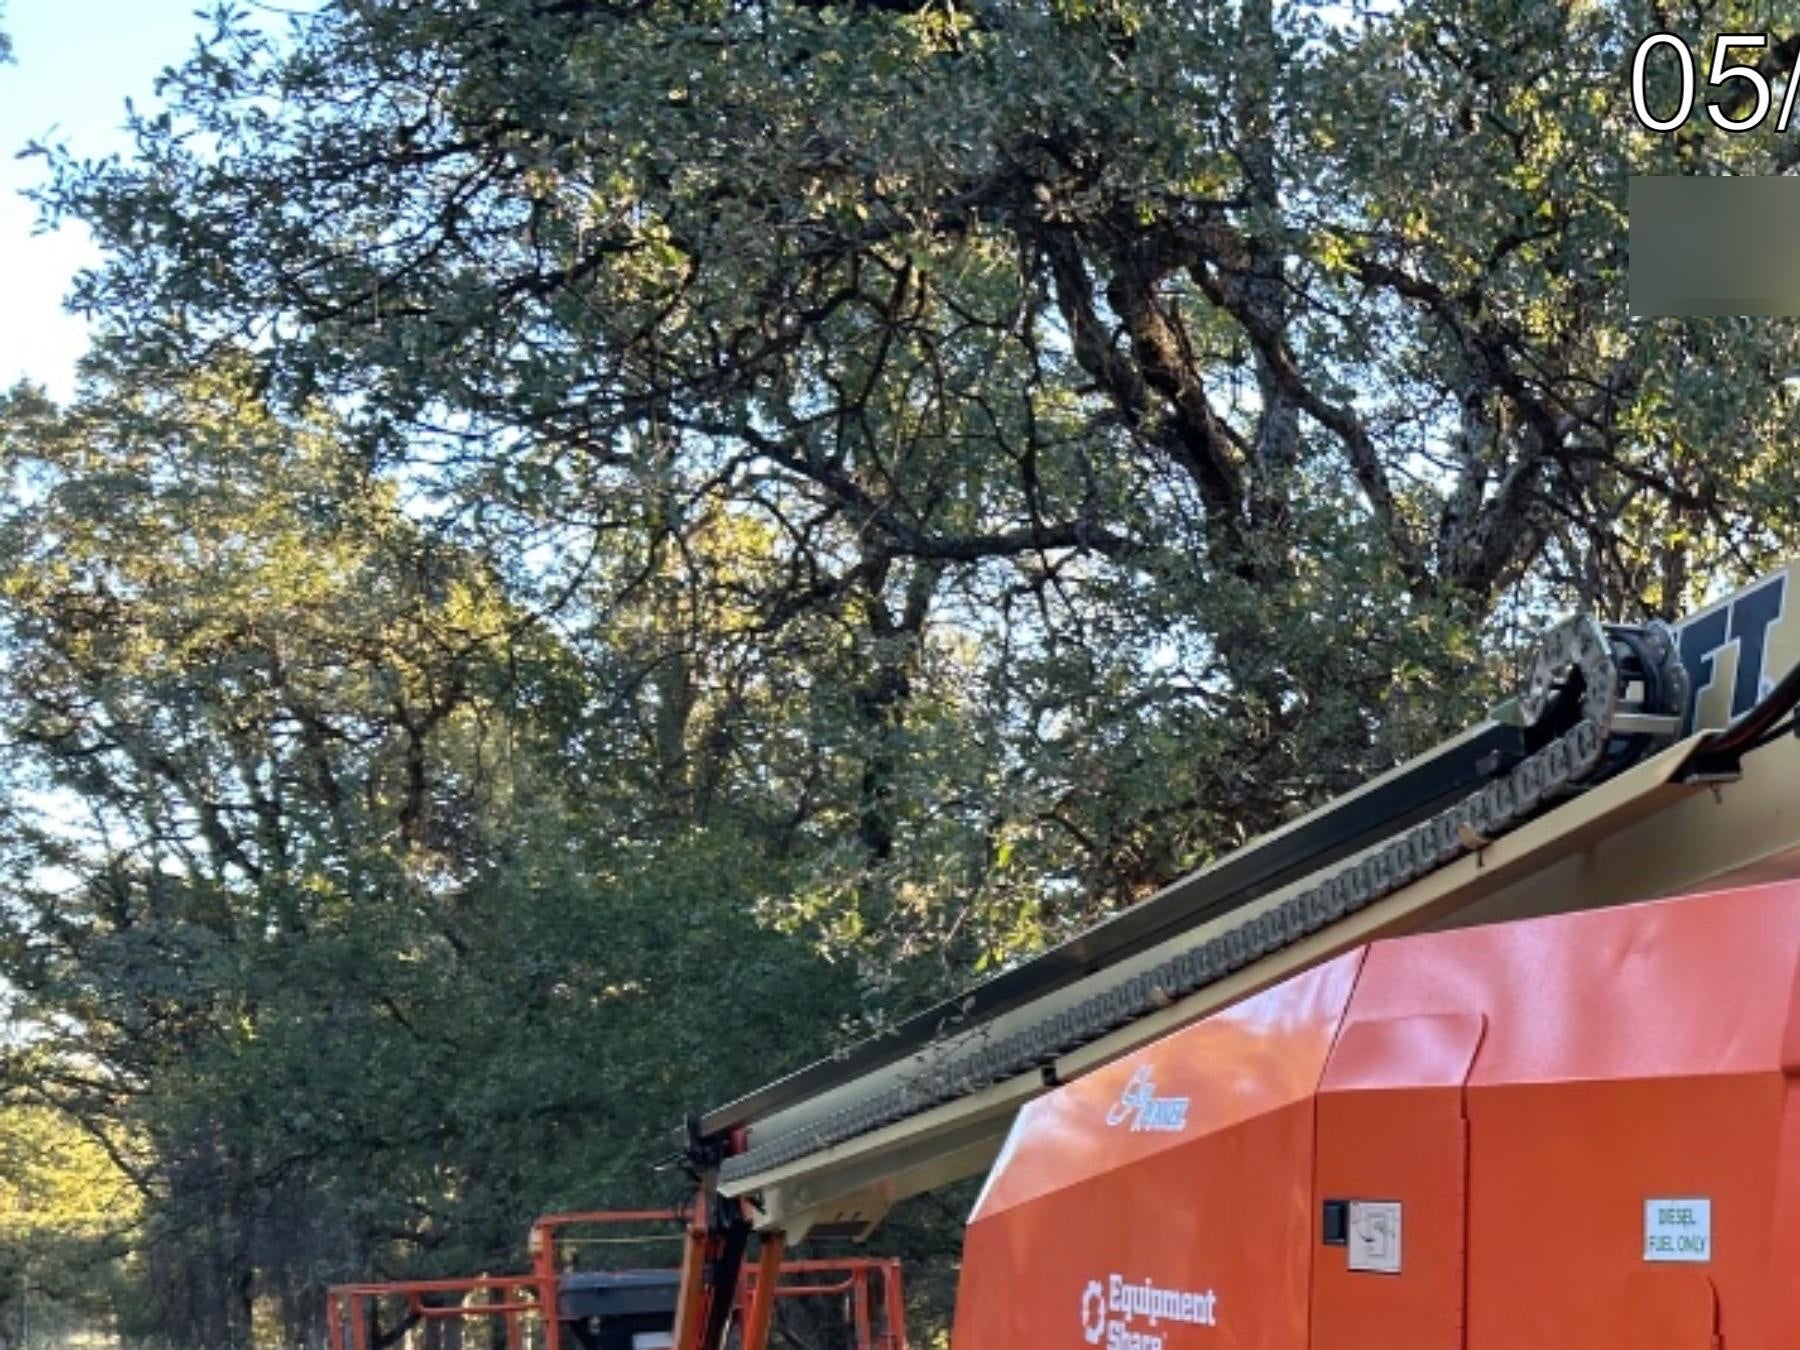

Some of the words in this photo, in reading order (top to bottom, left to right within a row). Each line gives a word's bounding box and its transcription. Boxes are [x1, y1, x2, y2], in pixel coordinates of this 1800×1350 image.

[1658, 1207, 1696, 1225] DIESEL
[1649, 1235, 1674, 1252] FUEL
[1109, 1273, 1217, 1328] Equipment
